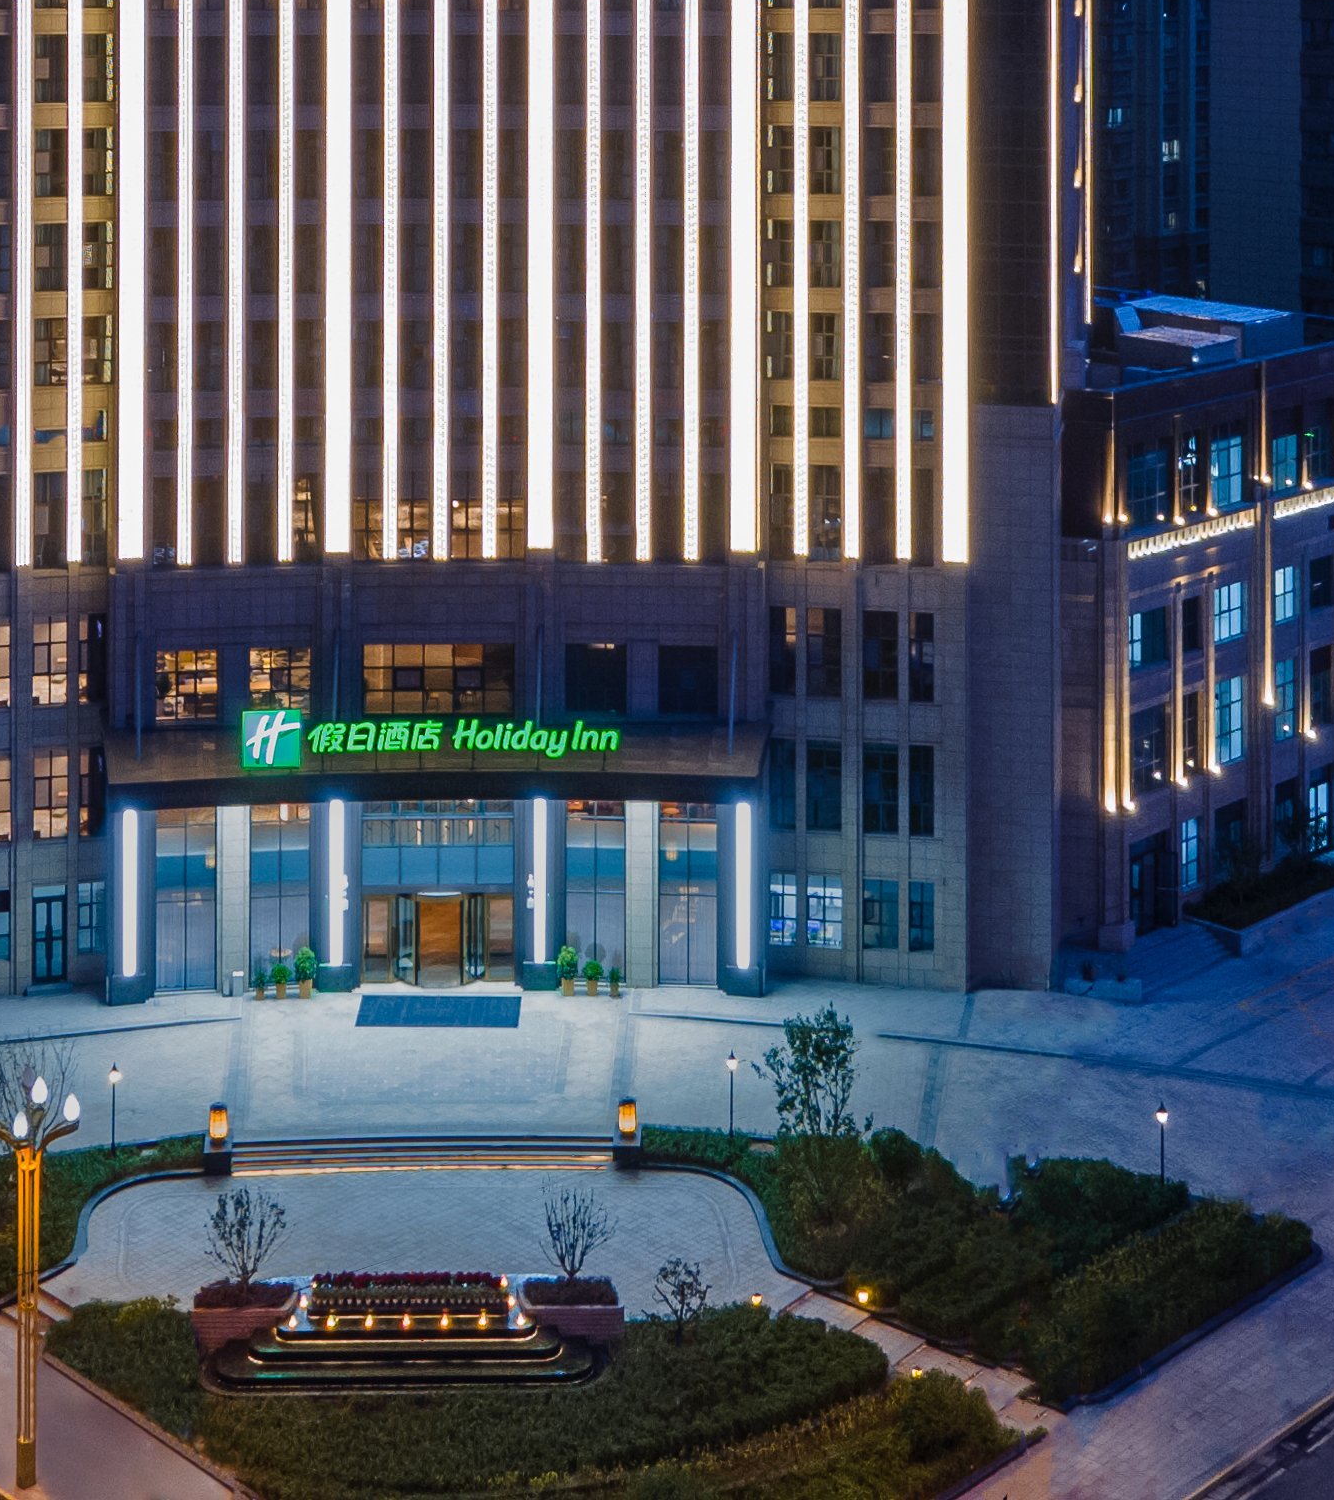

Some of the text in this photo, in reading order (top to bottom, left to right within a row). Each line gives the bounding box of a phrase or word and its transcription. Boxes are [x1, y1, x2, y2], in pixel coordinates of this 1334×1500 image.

[308, 720, 442, 753] 假日酒店
[452, 719, 619, 758] Holiday Inn
